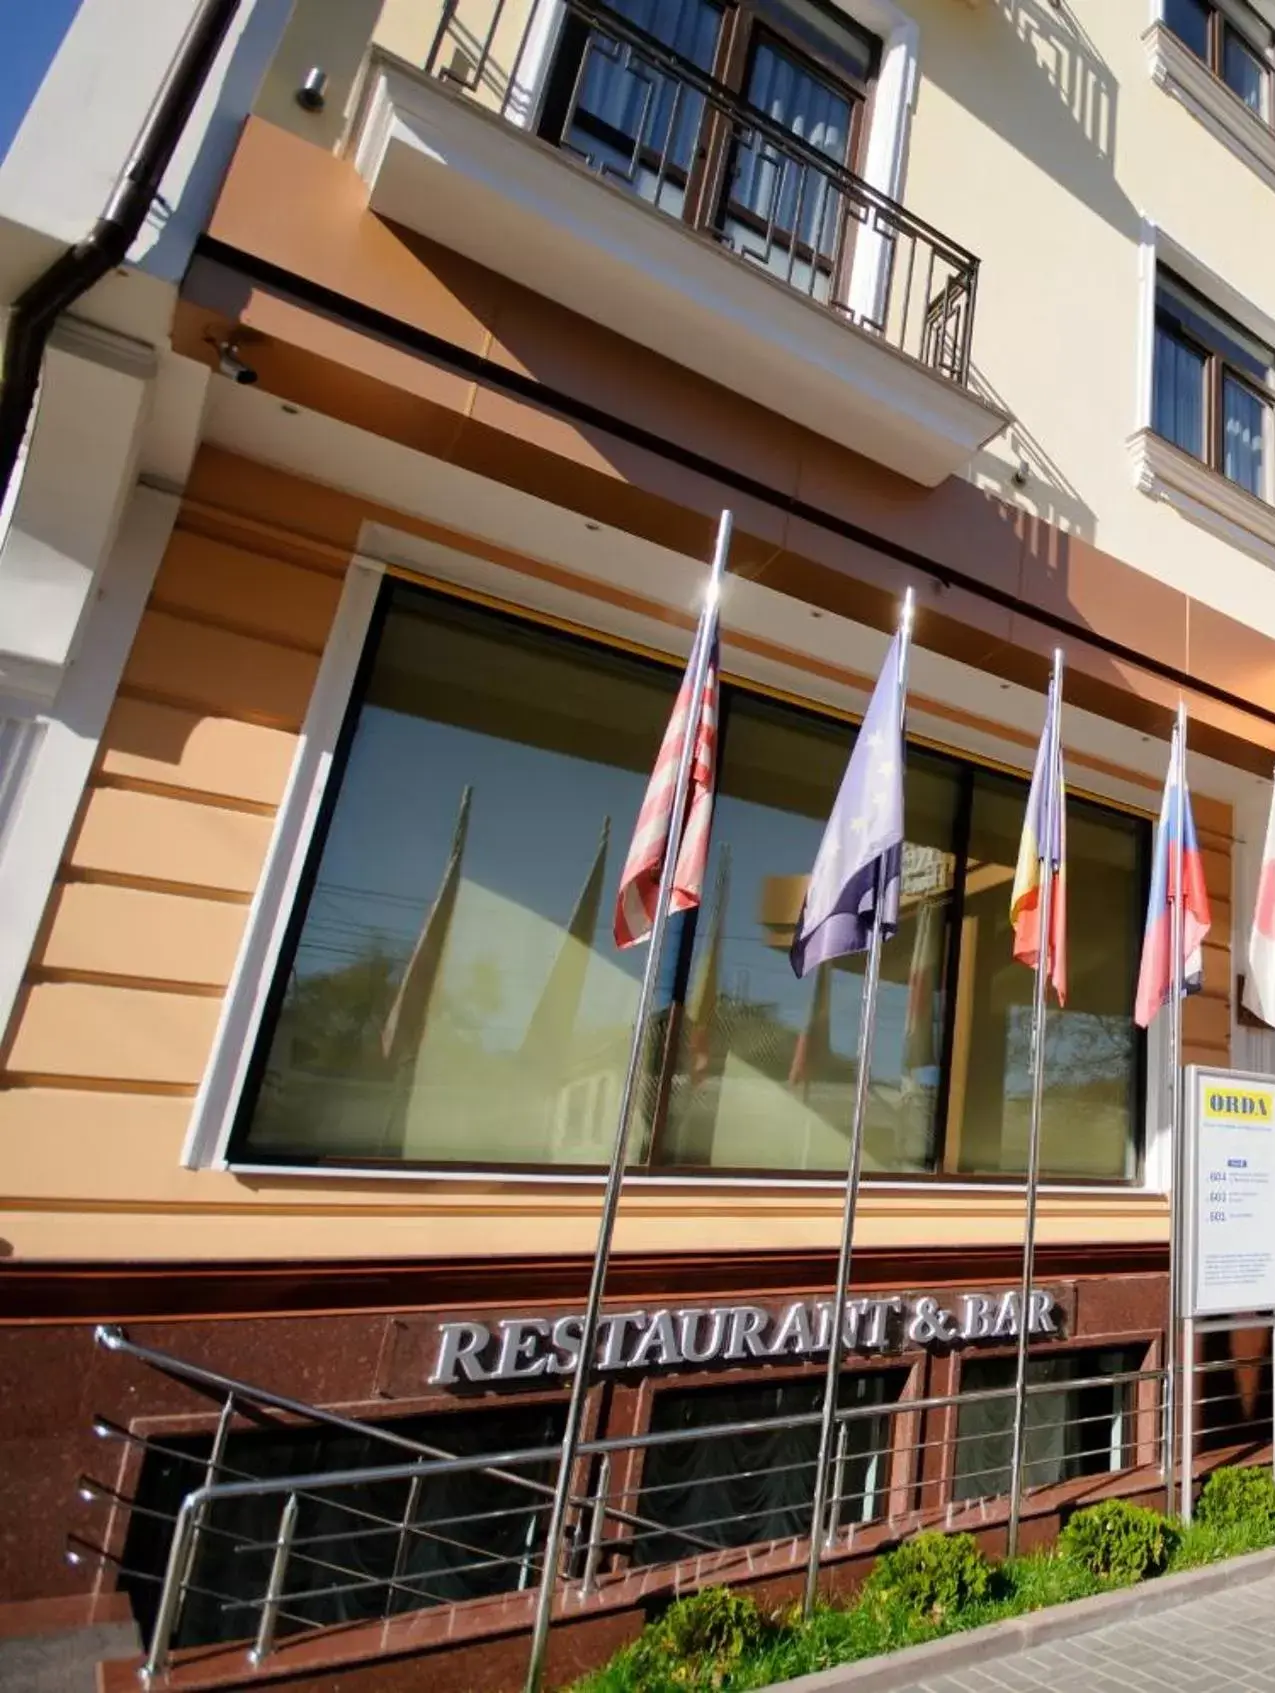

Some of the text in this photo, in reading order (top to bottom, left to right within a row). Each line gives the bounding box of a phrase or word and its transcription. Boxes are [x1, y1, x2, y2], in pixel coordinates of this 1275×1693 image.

[1209, 1093, 1268, 1117] ORDA
[427, 1290, 1058, 1384] RESTAURANT & BAR
